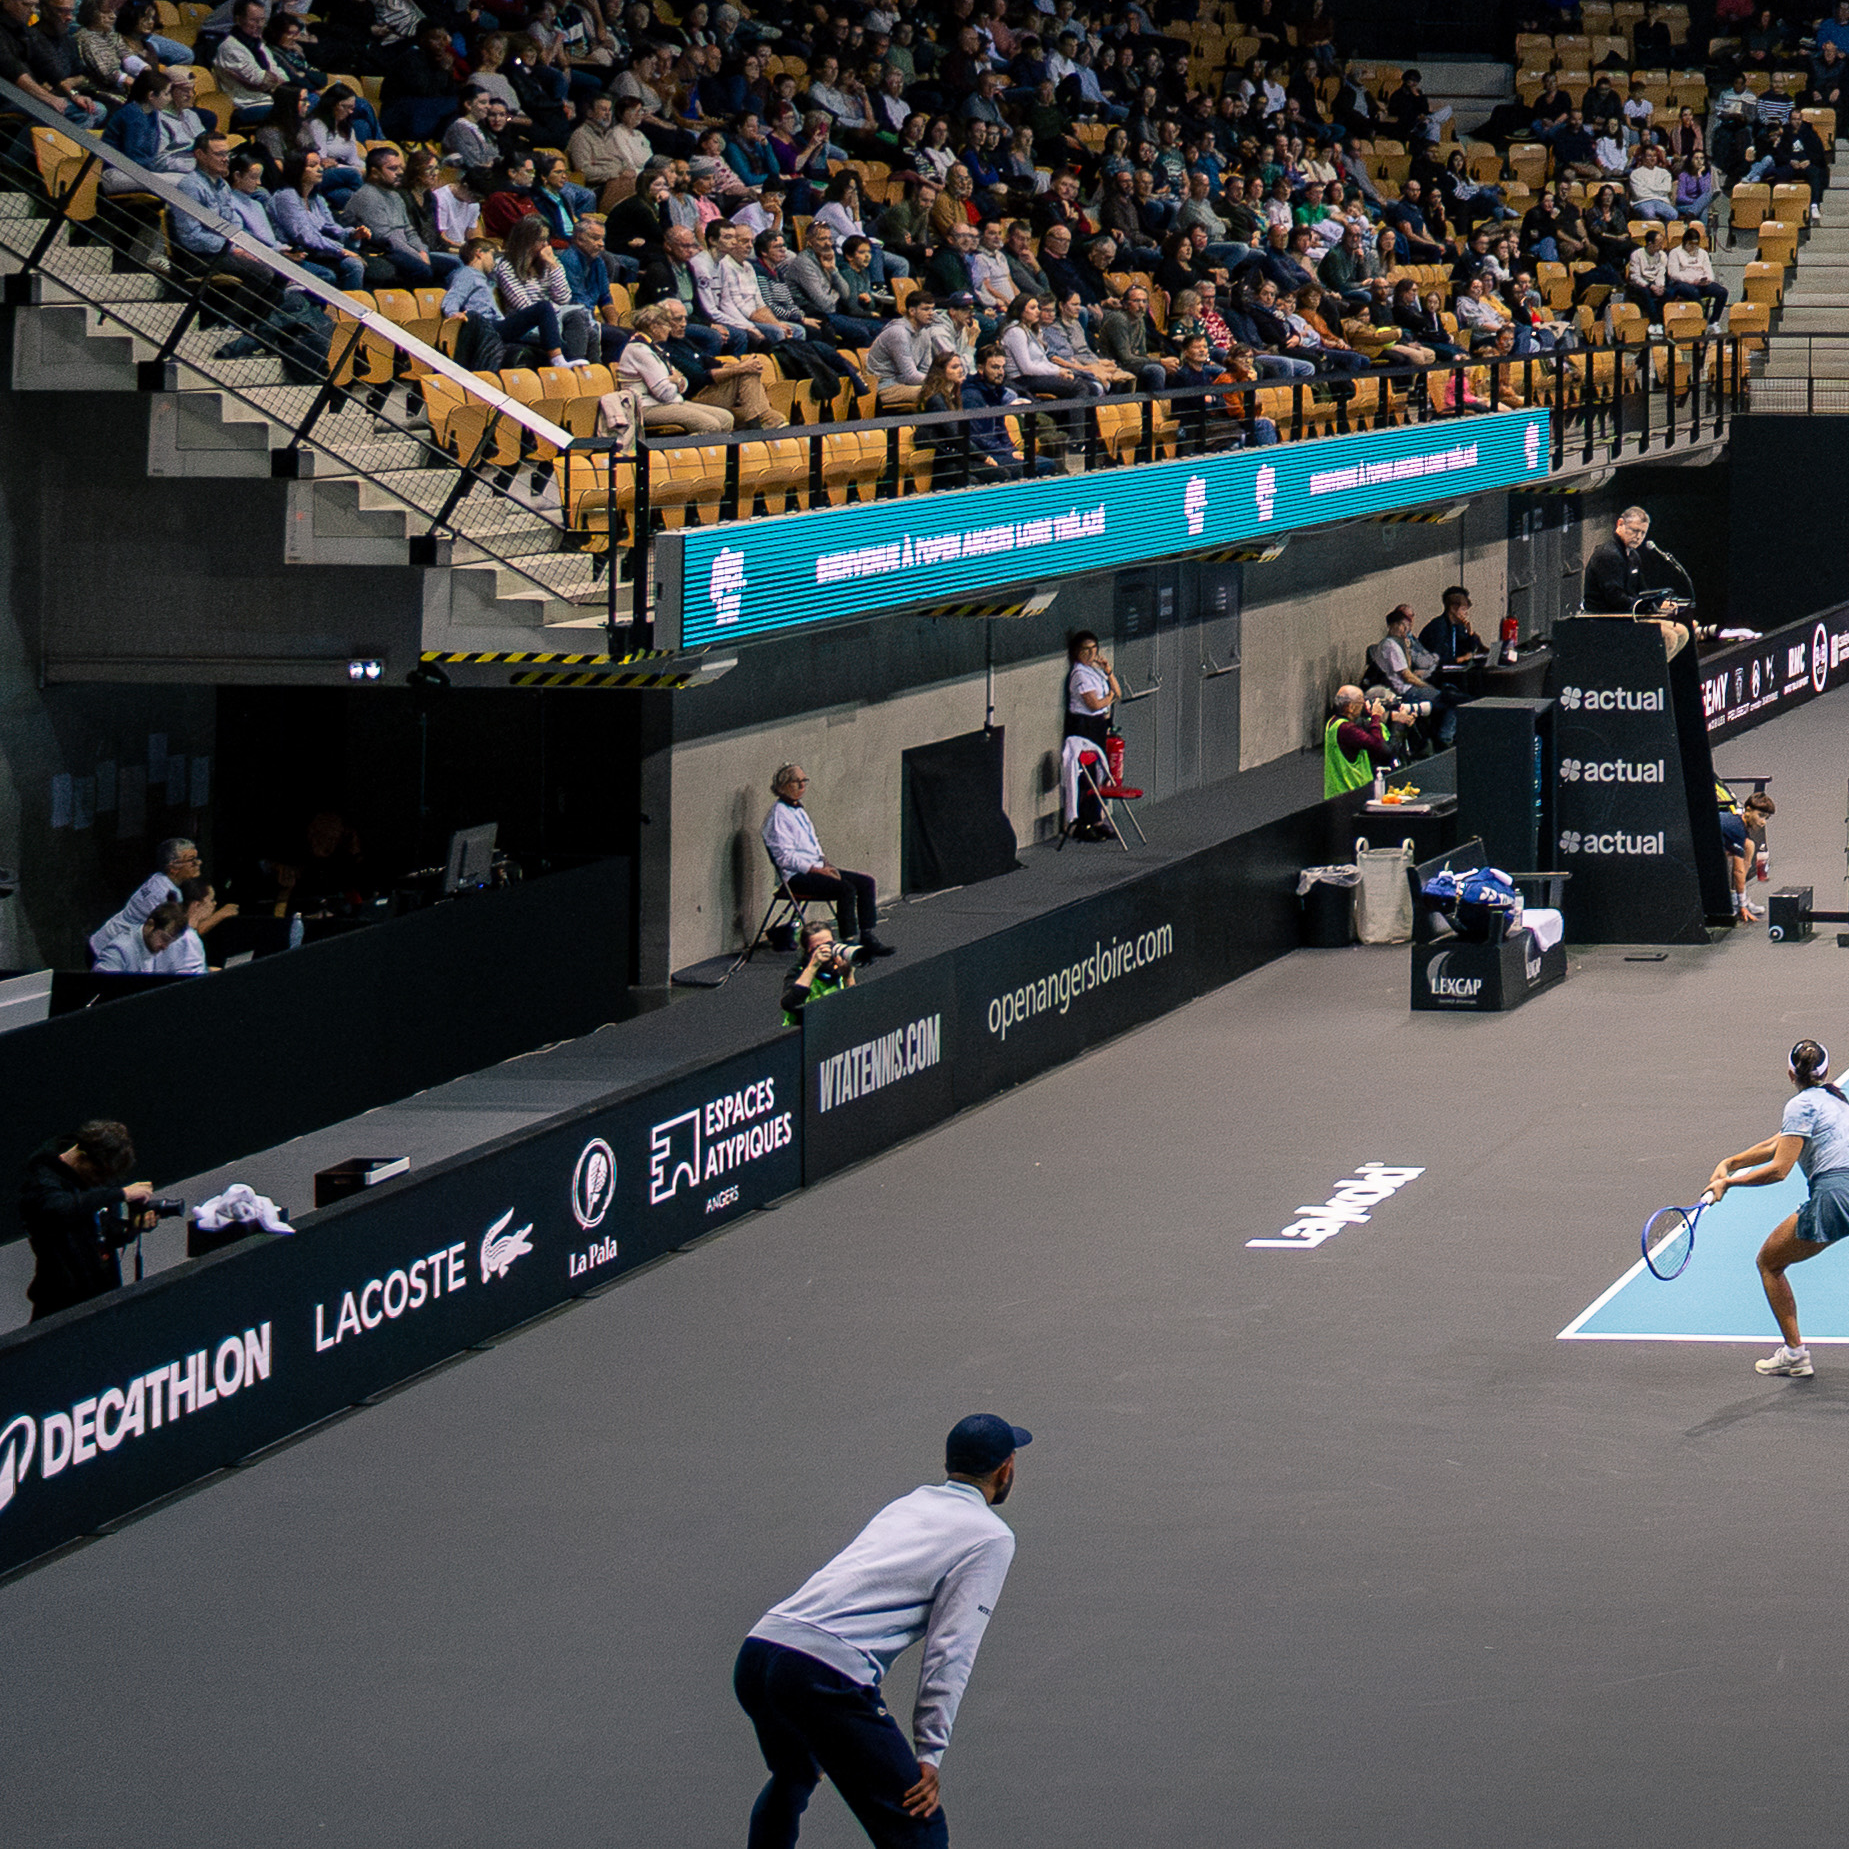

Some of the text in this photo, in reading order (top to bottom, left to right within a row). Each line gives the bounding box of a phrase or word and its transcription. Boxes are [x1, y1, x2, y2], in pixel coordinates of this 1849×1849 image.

[1584, 686, 1664, 712] actual
[1584, 759, 1664, 784] actual
[1584, 830, 1664, 855] actual
[988, 921, 1173, 1041] openangersloire.com
[1431, 977, 1483, 996] LEXCAP
[819, 1012, 941, 1113] WTATENNIS.COM
[704, 1076, 775, 1134] ESPACES
[704, 1111, 793, 1180] ATYPIQUES
[569, 1235, 618, 1279] La Pala
[314, 1241, 468, 1352] LACOSTE
[41, 1321, 272, 1479] DECATHLON
